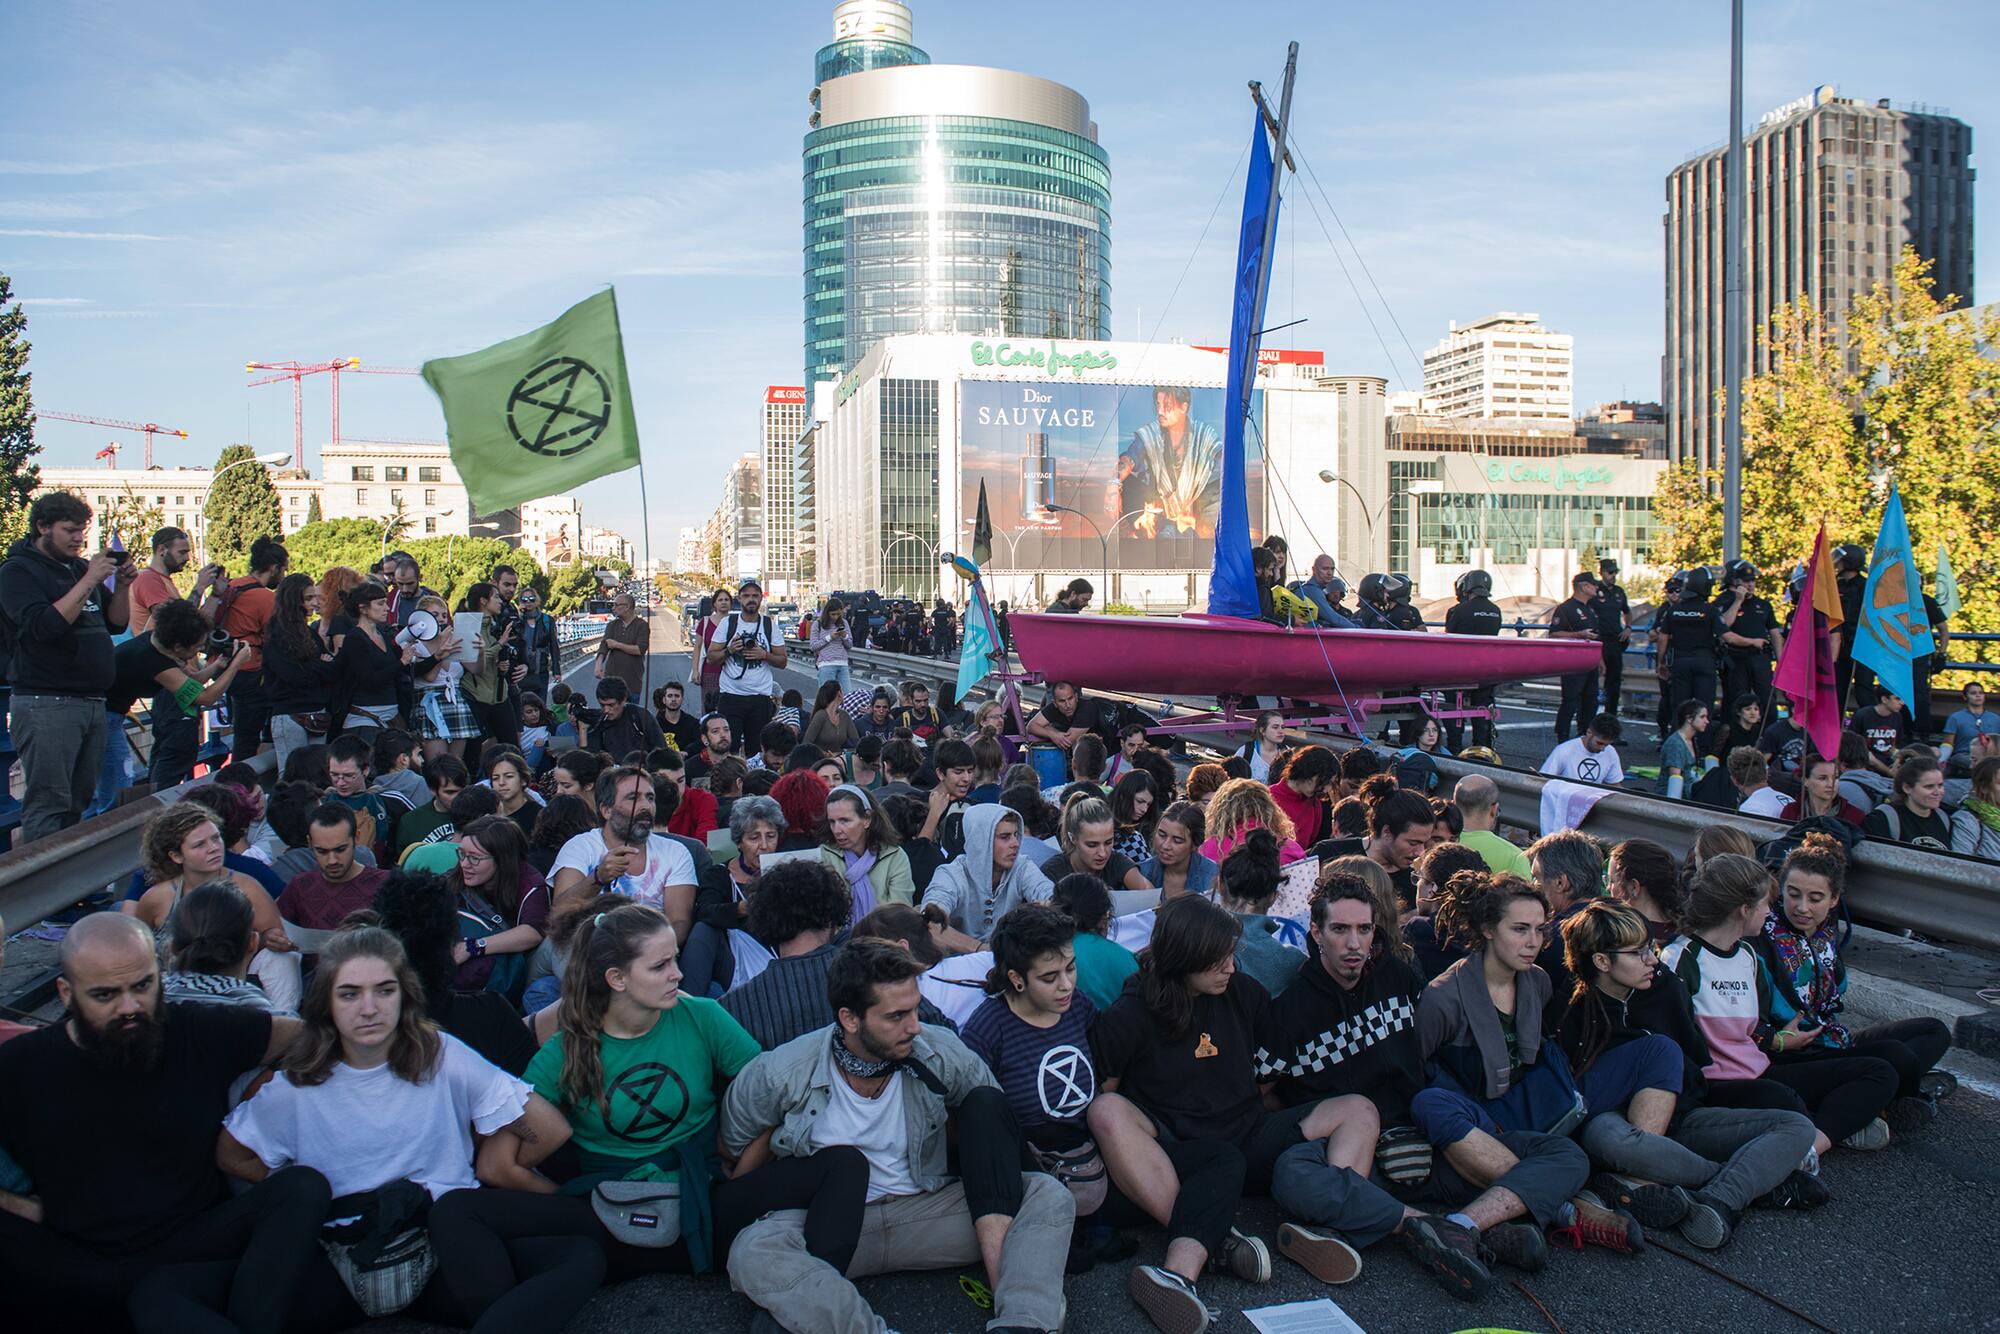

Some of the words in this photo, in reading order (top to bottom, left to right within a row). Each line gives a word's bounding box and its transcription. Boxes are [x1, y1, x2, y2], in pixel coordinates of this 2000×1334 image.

[836, 15, 862, 39] EY
[971, 341, 993, 366] El
[995, 343, 1045, 367] Corte
[1047, 340, 1118, 376] Inglés
[1023, 389, 1052, 403] Dior
[978, 406, 1095, 427] SAUVAGE
[1487, 460, 1506, 482] El
[1509, 464, 1551, 483] Corte
[1553, 457, 1615, 490] Inglés
